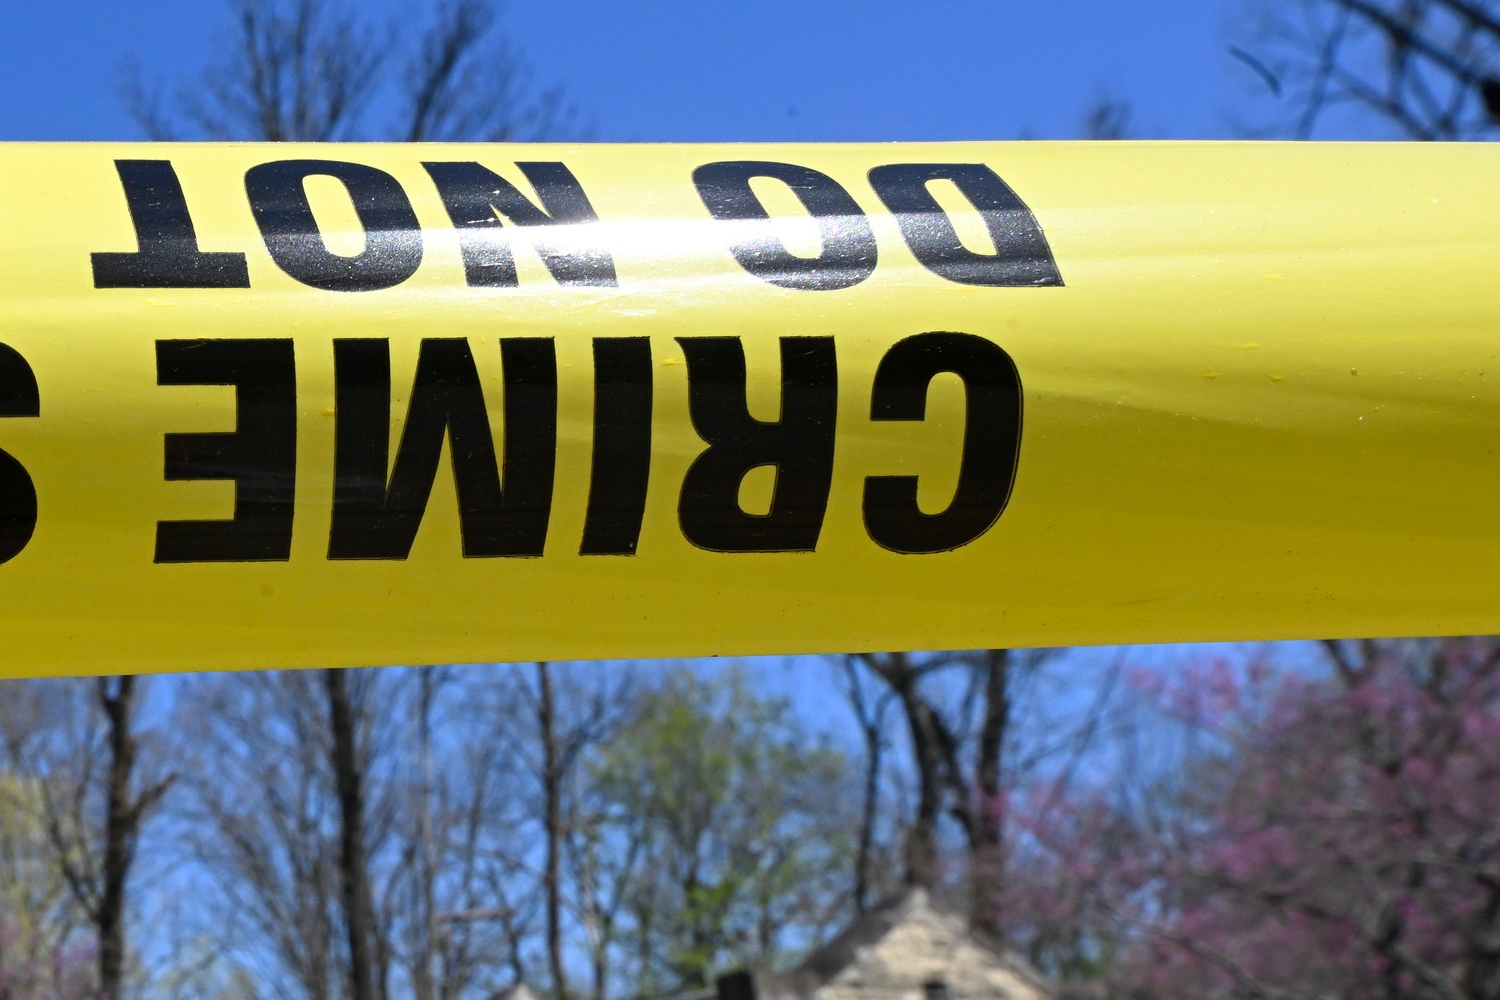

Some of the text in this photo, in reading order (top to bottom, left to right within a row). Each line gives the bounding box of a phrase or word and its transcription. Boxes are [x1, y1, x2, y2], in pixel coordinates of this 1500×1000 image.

[90, 157, 619, 293] NOT
[690, 160, 1067, 291] DO
[152, 330, 1025, 566] CRIME
